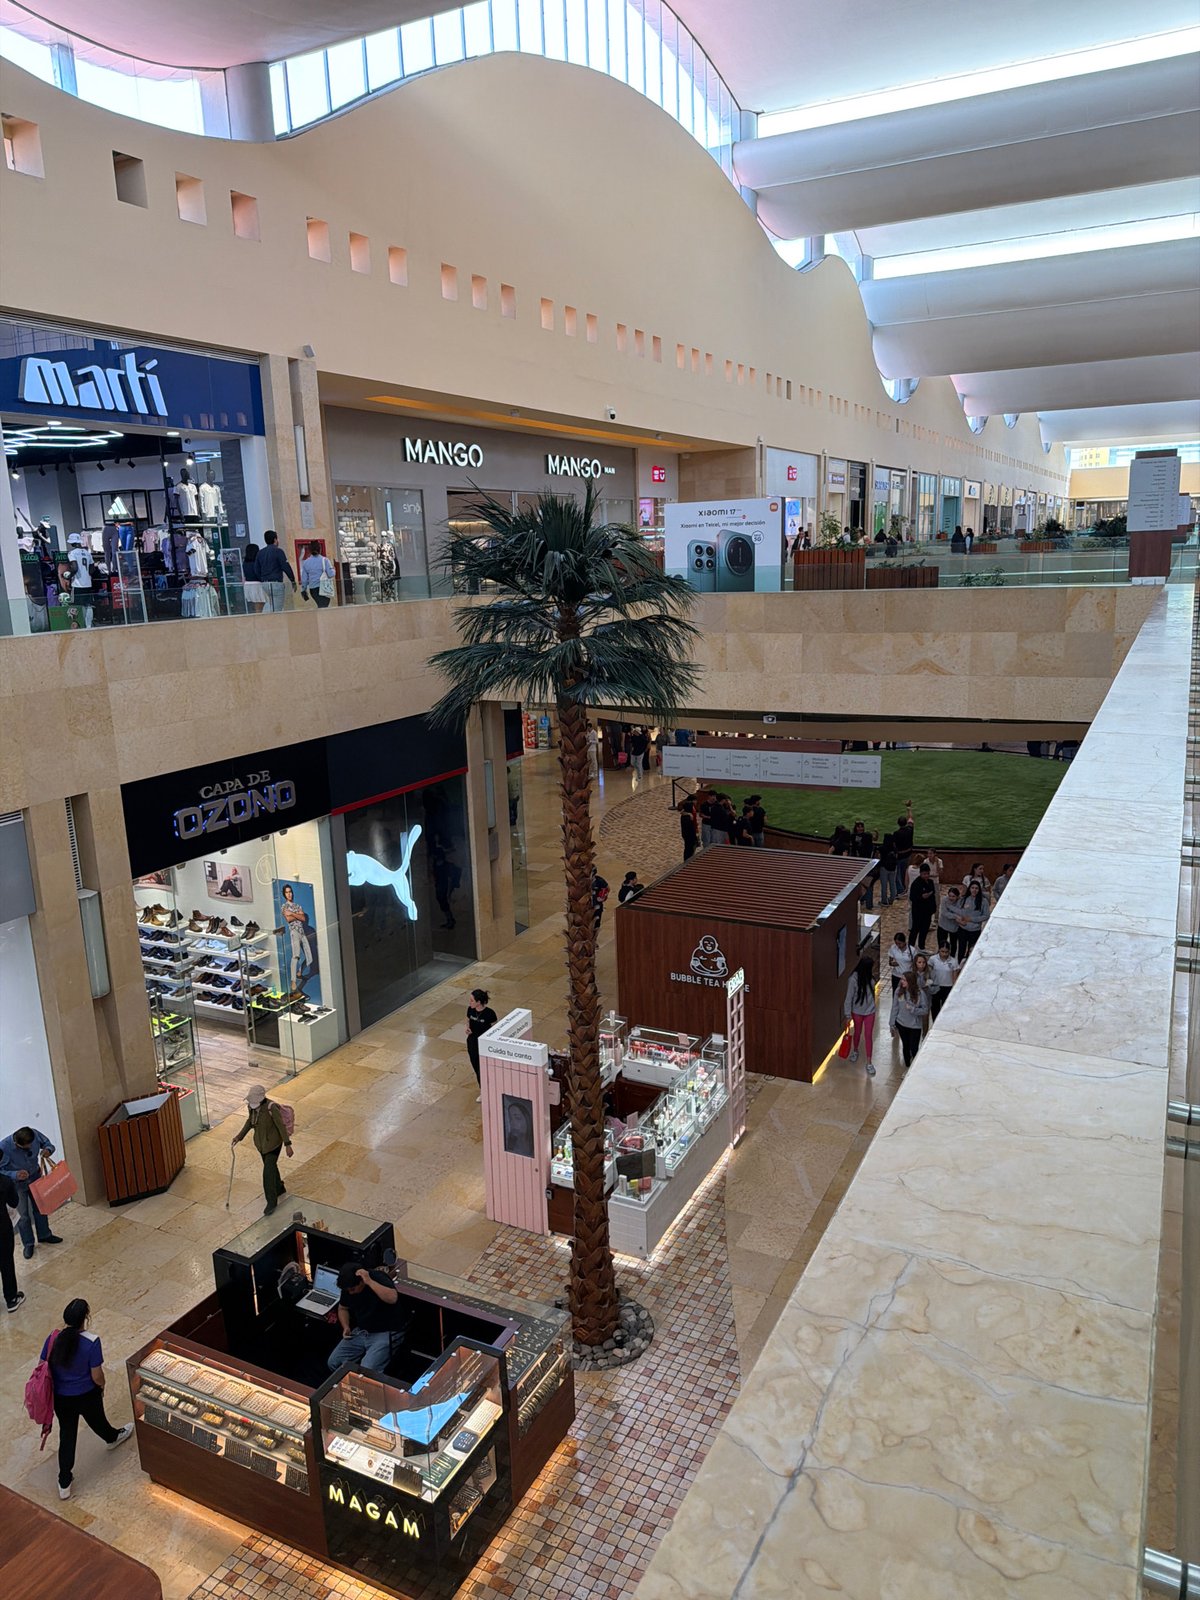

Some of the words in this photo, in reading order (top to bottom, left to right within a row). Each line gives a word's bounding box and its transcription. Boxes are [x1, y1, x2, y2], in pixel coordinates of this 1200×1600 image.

[404, 437, 483, 468] MANGO
[547, 453, 601, 479] MANGO
[81, 557, 88, 571] 9
[200, 779, 245, 800] CAPA
[247, 770, 271, 787] DE
[174, 780, 297, 840] OZONO
[670, 972, 702, 985] BUBBLE
[703, 977, 721, 988] TEA
[329, 1484, 420, 1539] MAGAM
